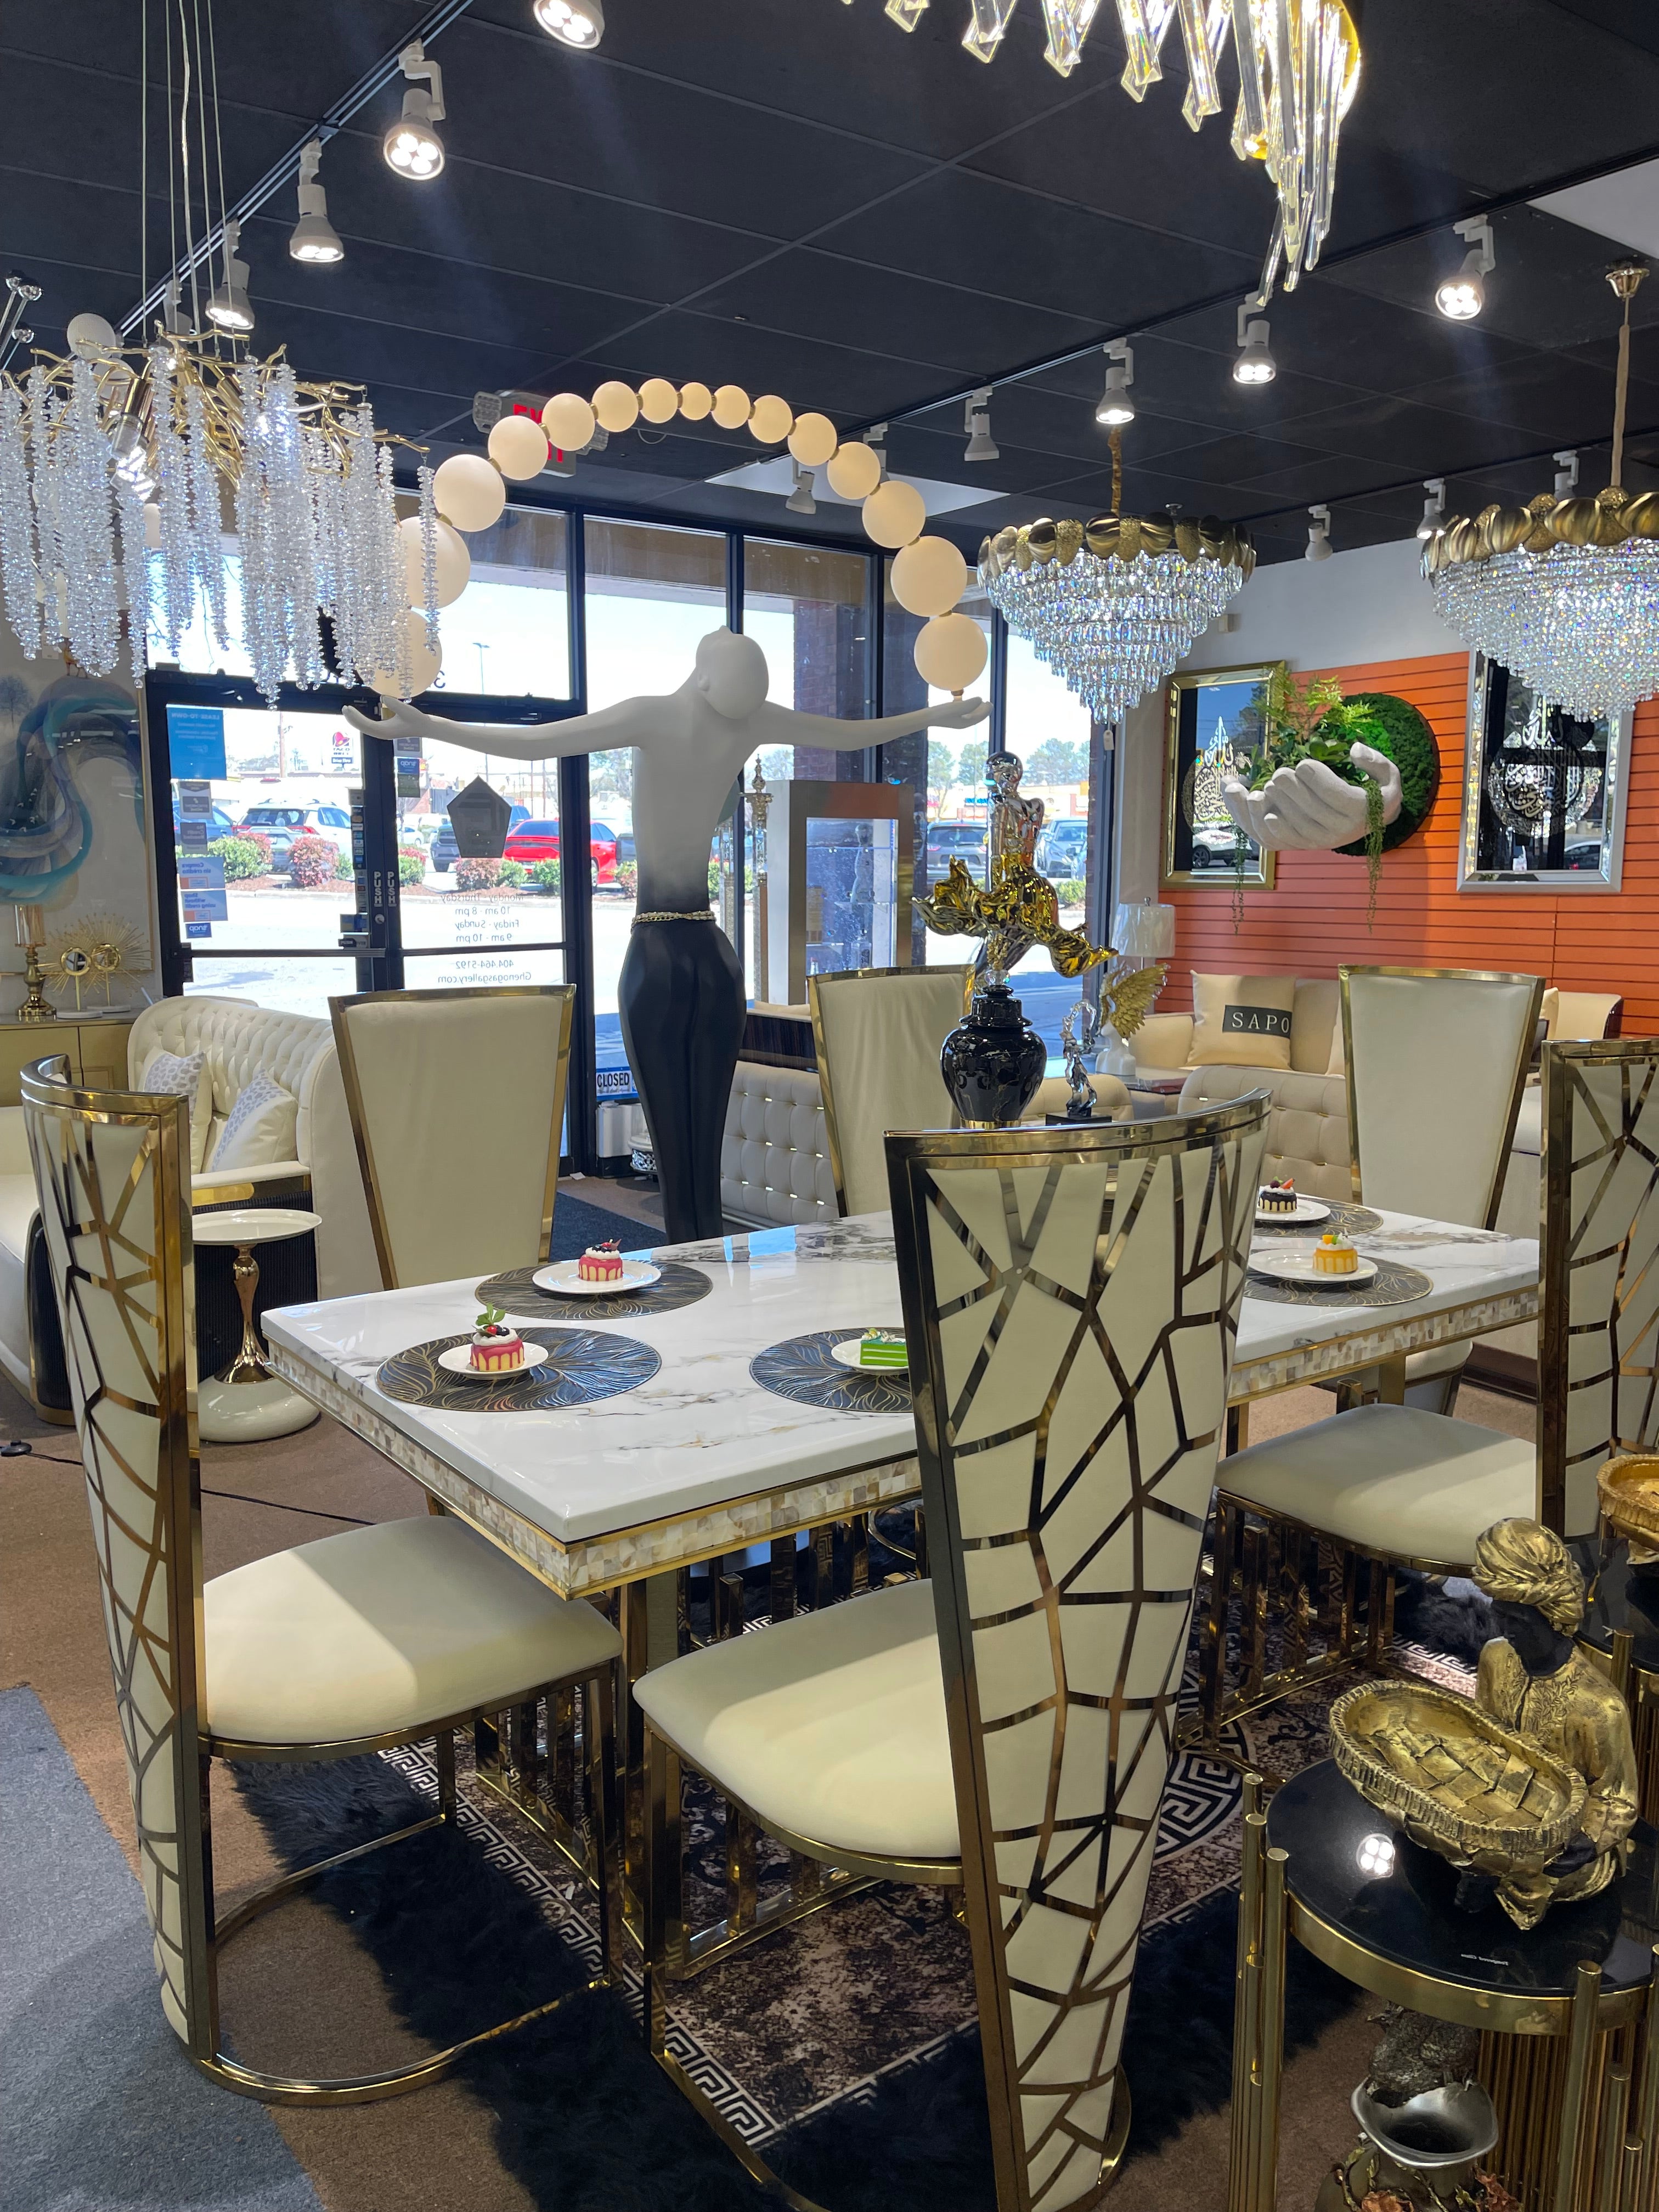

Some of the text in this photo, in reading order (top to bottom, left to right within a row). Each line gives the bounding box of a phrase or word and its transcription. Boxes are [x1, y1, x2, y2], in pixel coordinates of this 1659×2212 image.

[374, 871, 382, 904] PUSH
[387, 871, 396, 904] PUSH
[1232, 1012, 1290, 1033] SAPO
[597, 1073, 630, 1087] CLOSED
